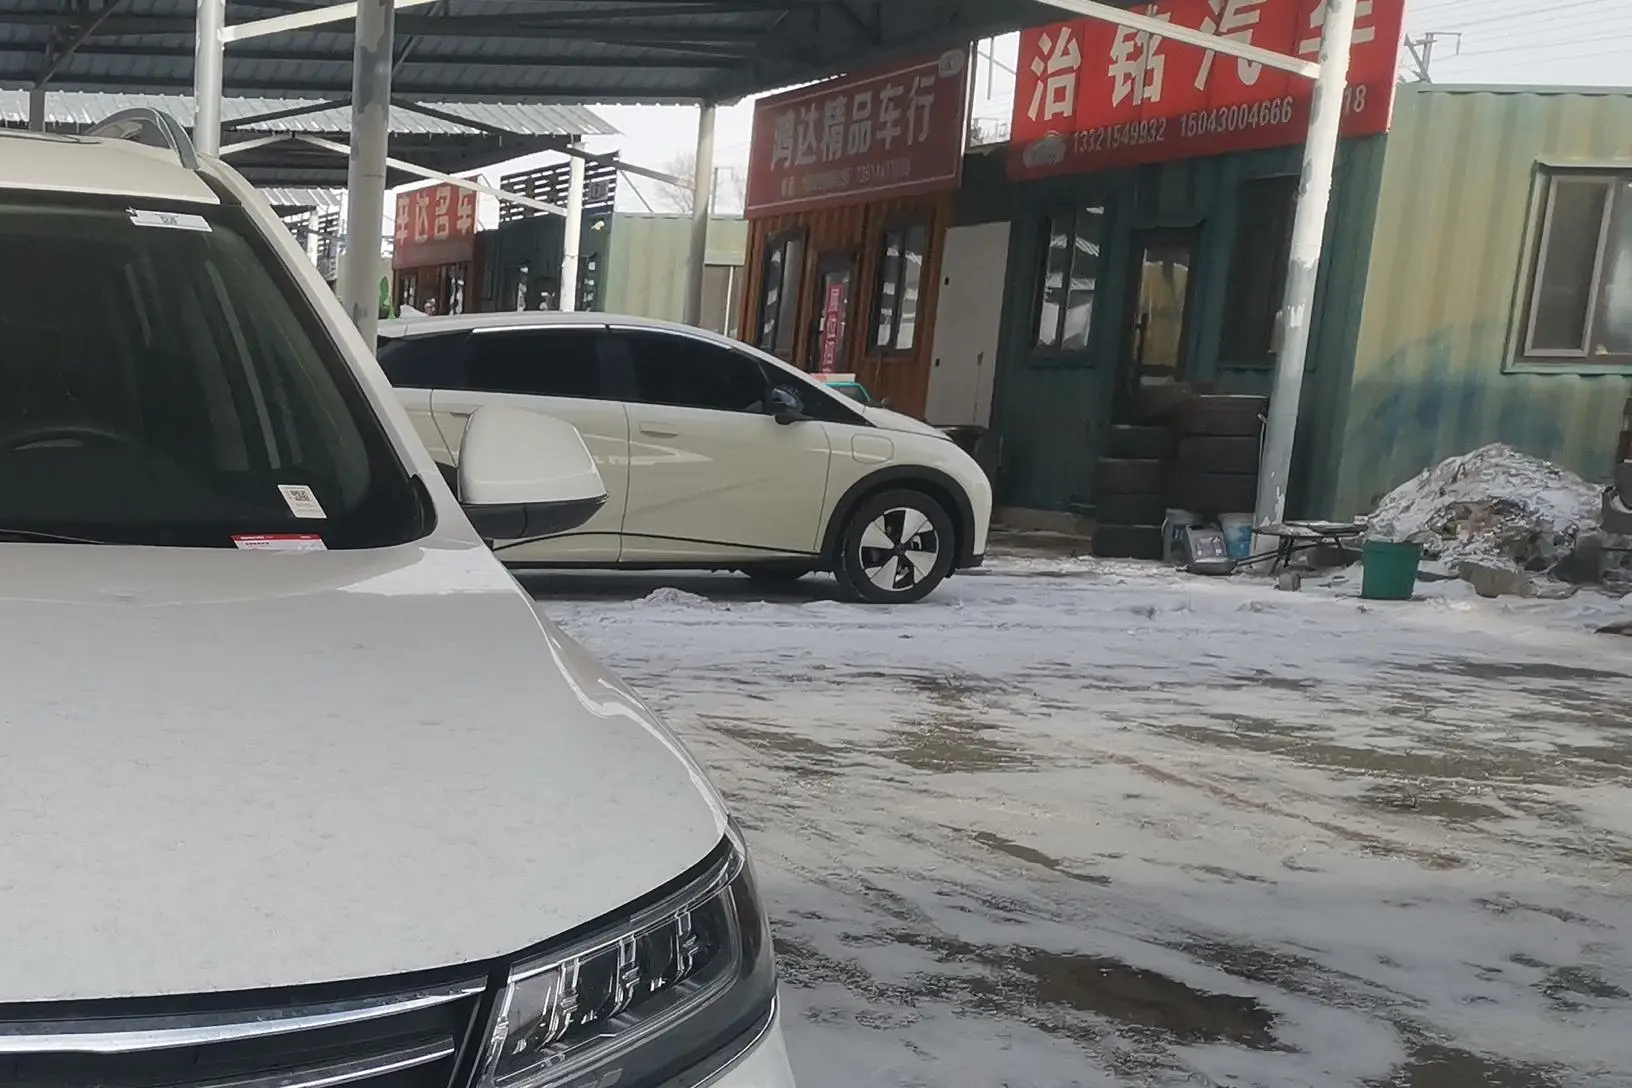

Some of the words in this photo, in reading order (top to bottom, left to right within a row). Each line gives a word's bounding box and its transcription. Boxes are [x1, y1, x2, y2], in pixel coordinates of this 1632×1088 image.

[770, 74, 936, 172] 鸿达精品车行
[1179, 95, 1293, 138] 15043004666
